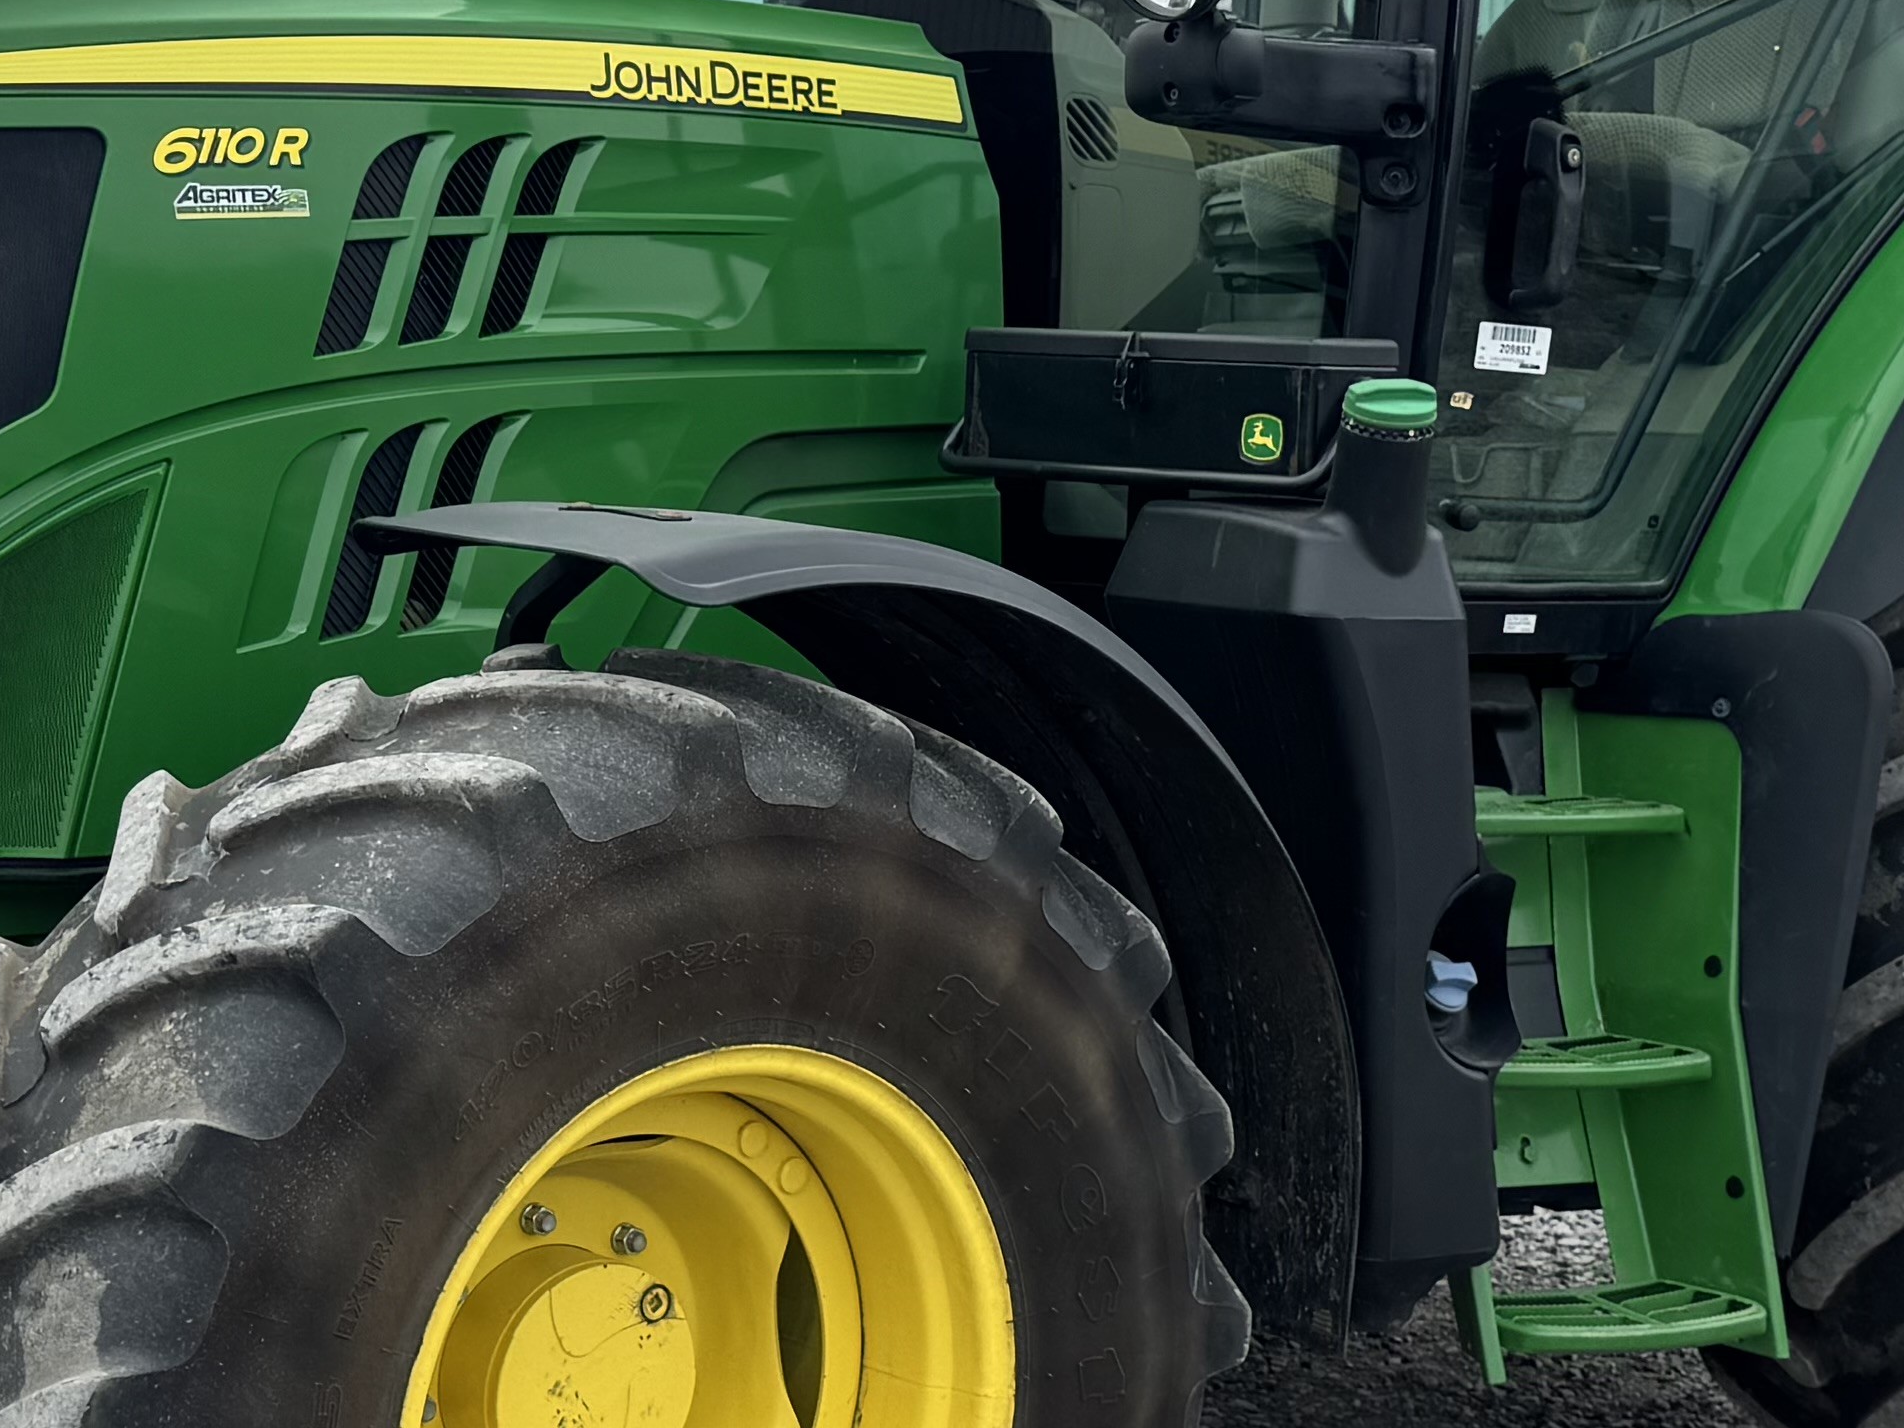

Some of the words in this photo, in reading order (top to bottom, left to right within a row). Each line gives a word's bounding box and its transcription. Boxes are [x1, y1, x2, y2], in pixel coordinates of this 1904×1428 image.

[589, 51, 703, 99] JOHN
[708, 59, 839, 110] DEERE
[176, 184, 280, 204] AGRITEX
